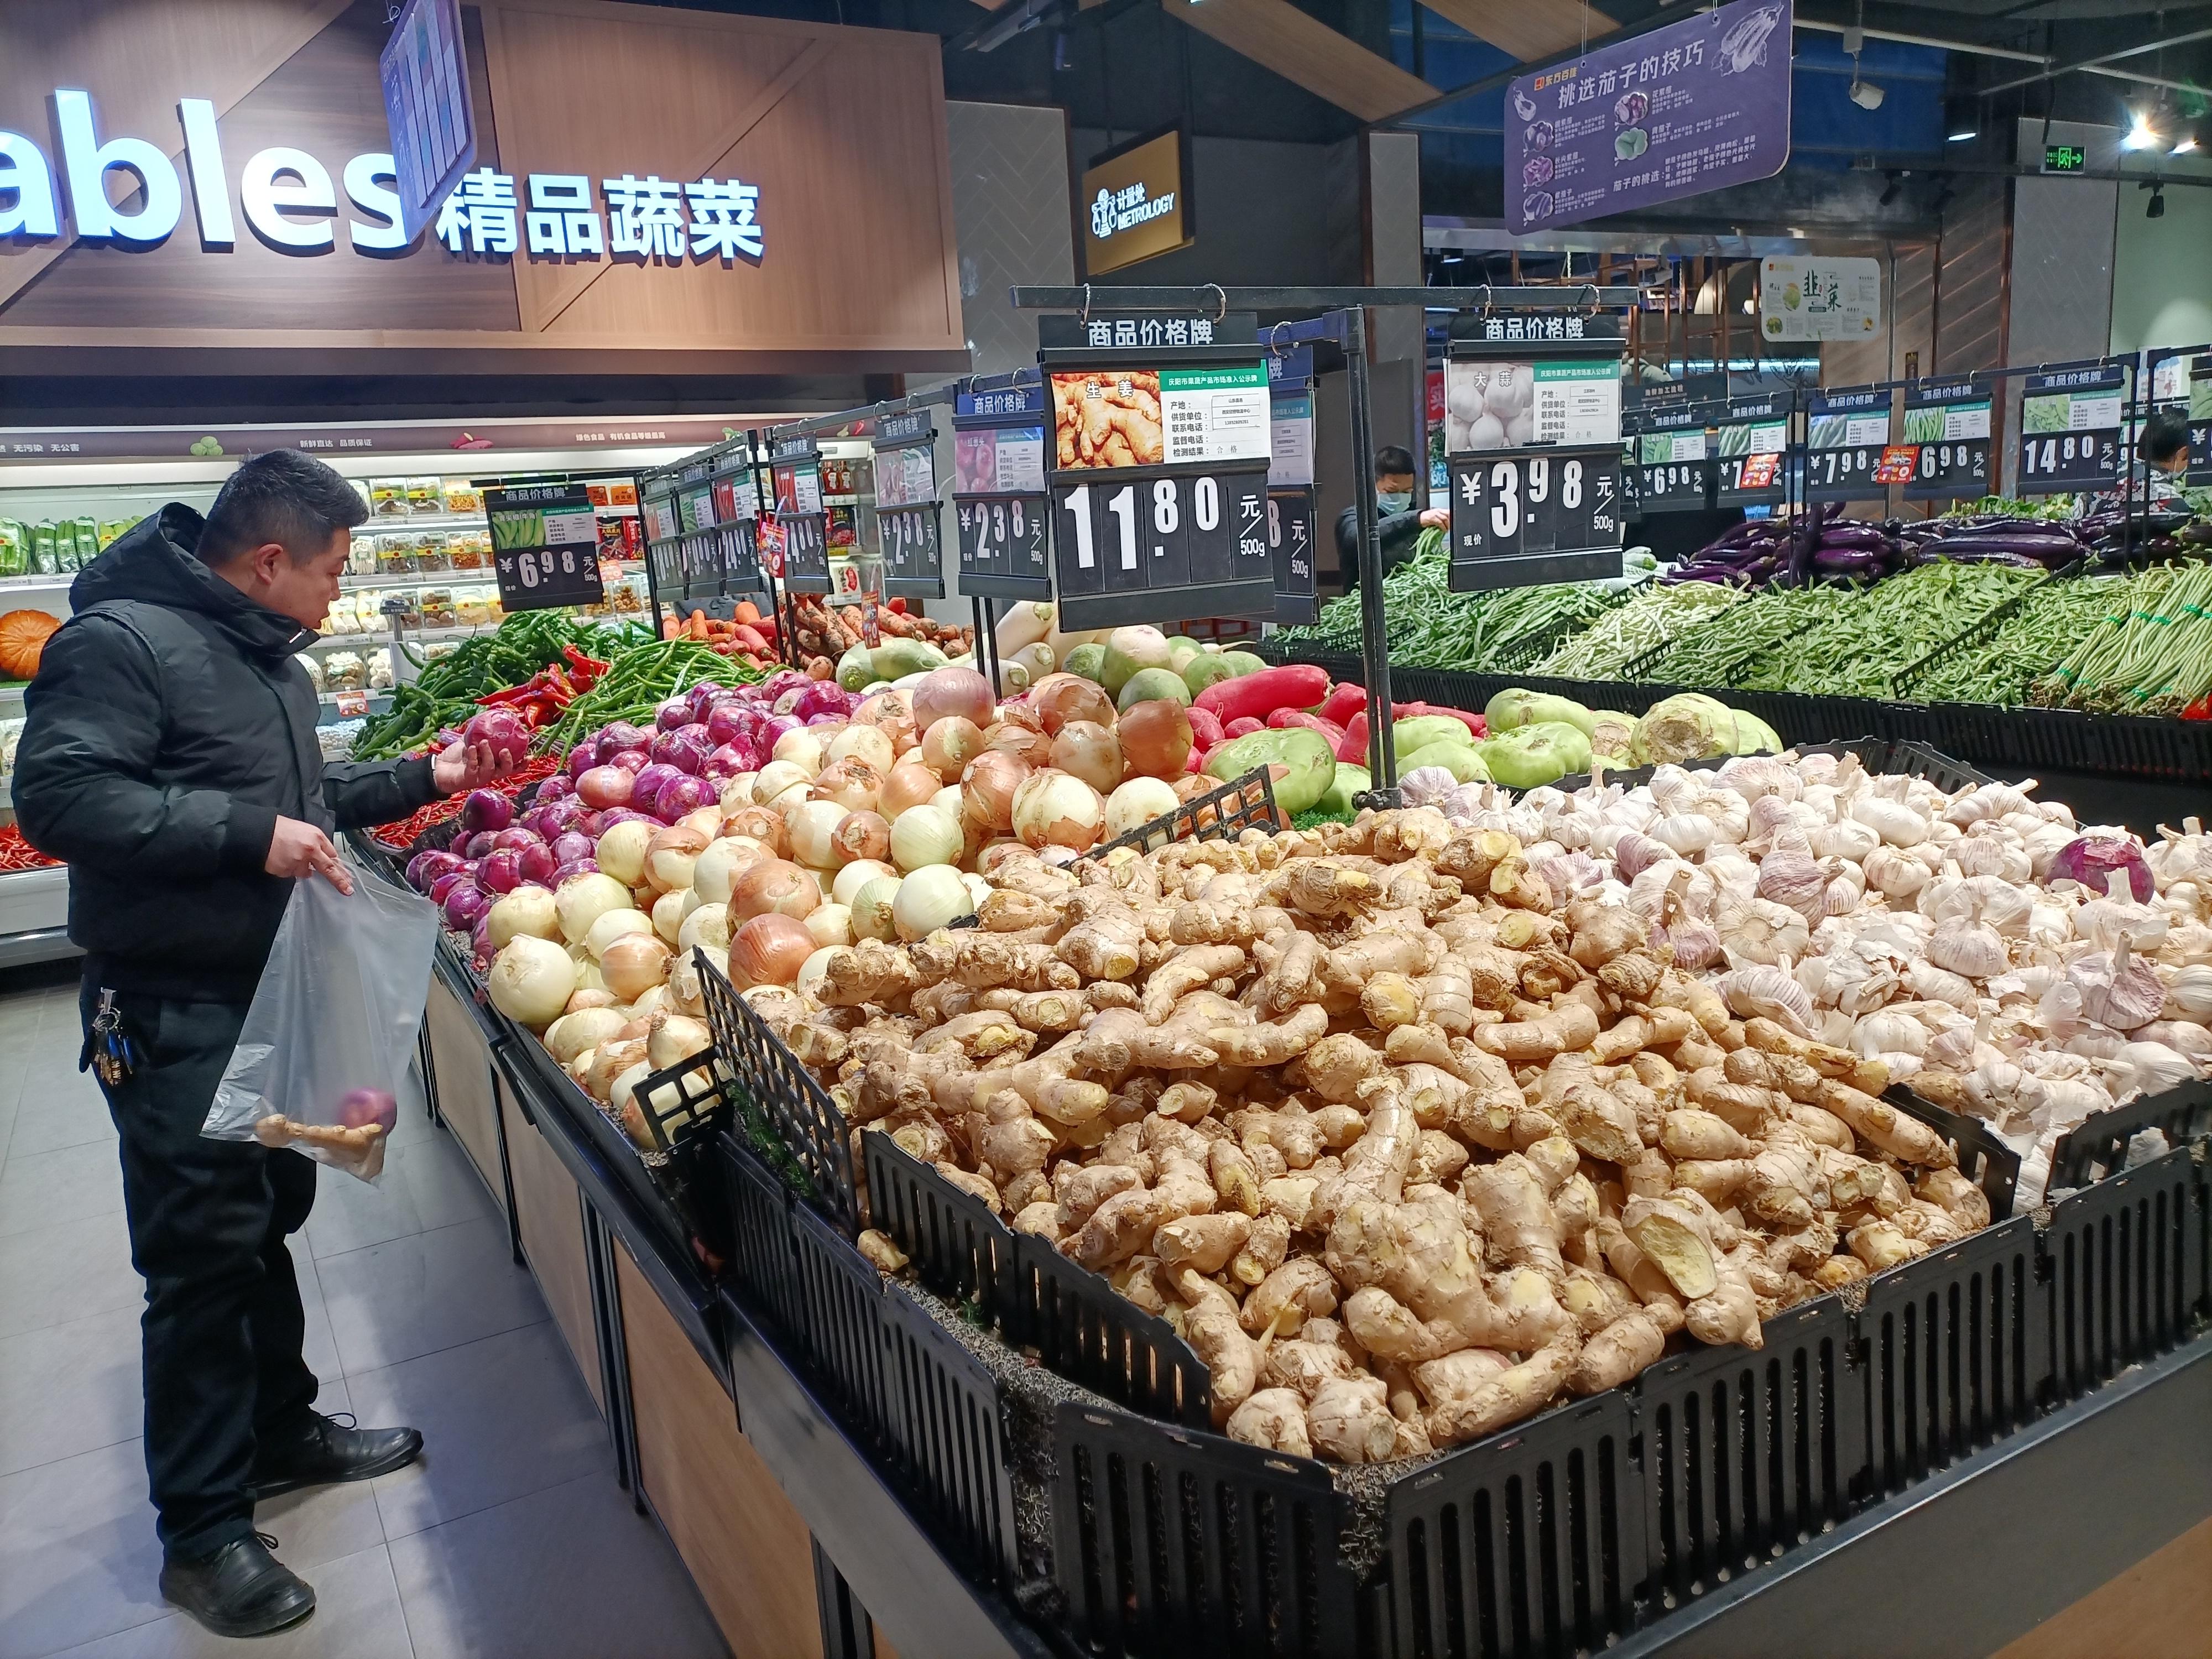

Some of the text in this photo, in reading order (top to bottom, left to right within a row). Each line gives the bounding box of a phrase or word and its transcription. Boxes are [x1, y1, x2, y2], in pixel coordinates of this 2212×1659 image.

[1557, 39, 1705, 109] 挑选茄子的技巧
[1116, 182, 1146, 211] 计量处
[435, 168, 765, 259] 精品蔬菜
[1117, 192, 1175, 230] METROLOGY
[1087, 319, 1213, 347] 商品价格牌
[1485, 316, 1584, 340] 商品价格牌
[1168, 374, 1258, 387] 庆阳市果蔬产品市场准入公示牌
[2044, 371, 2102, 388] 商品价格牌
[1828, 394, 1874, 408] 商品价格牌
[1923, 385, 1972, 400] 商品价格牌
[973, 393, 1026, 415] 商品价格牌
[1732, 405, 1772, 418] 商品价格牌
[884, 416, 920, 438] 商品价格牌
[13, 444, 44, 452] 无污染
[50, 444, 80, 452] 无公害
[300, 439, 372, 448] 新鲜直达 品质保证
[505, 487, 566, 502] 商品价格牌
[1063, 477, 1220, 570] 11.80
[1463, 533, 1483, 547] 现价
